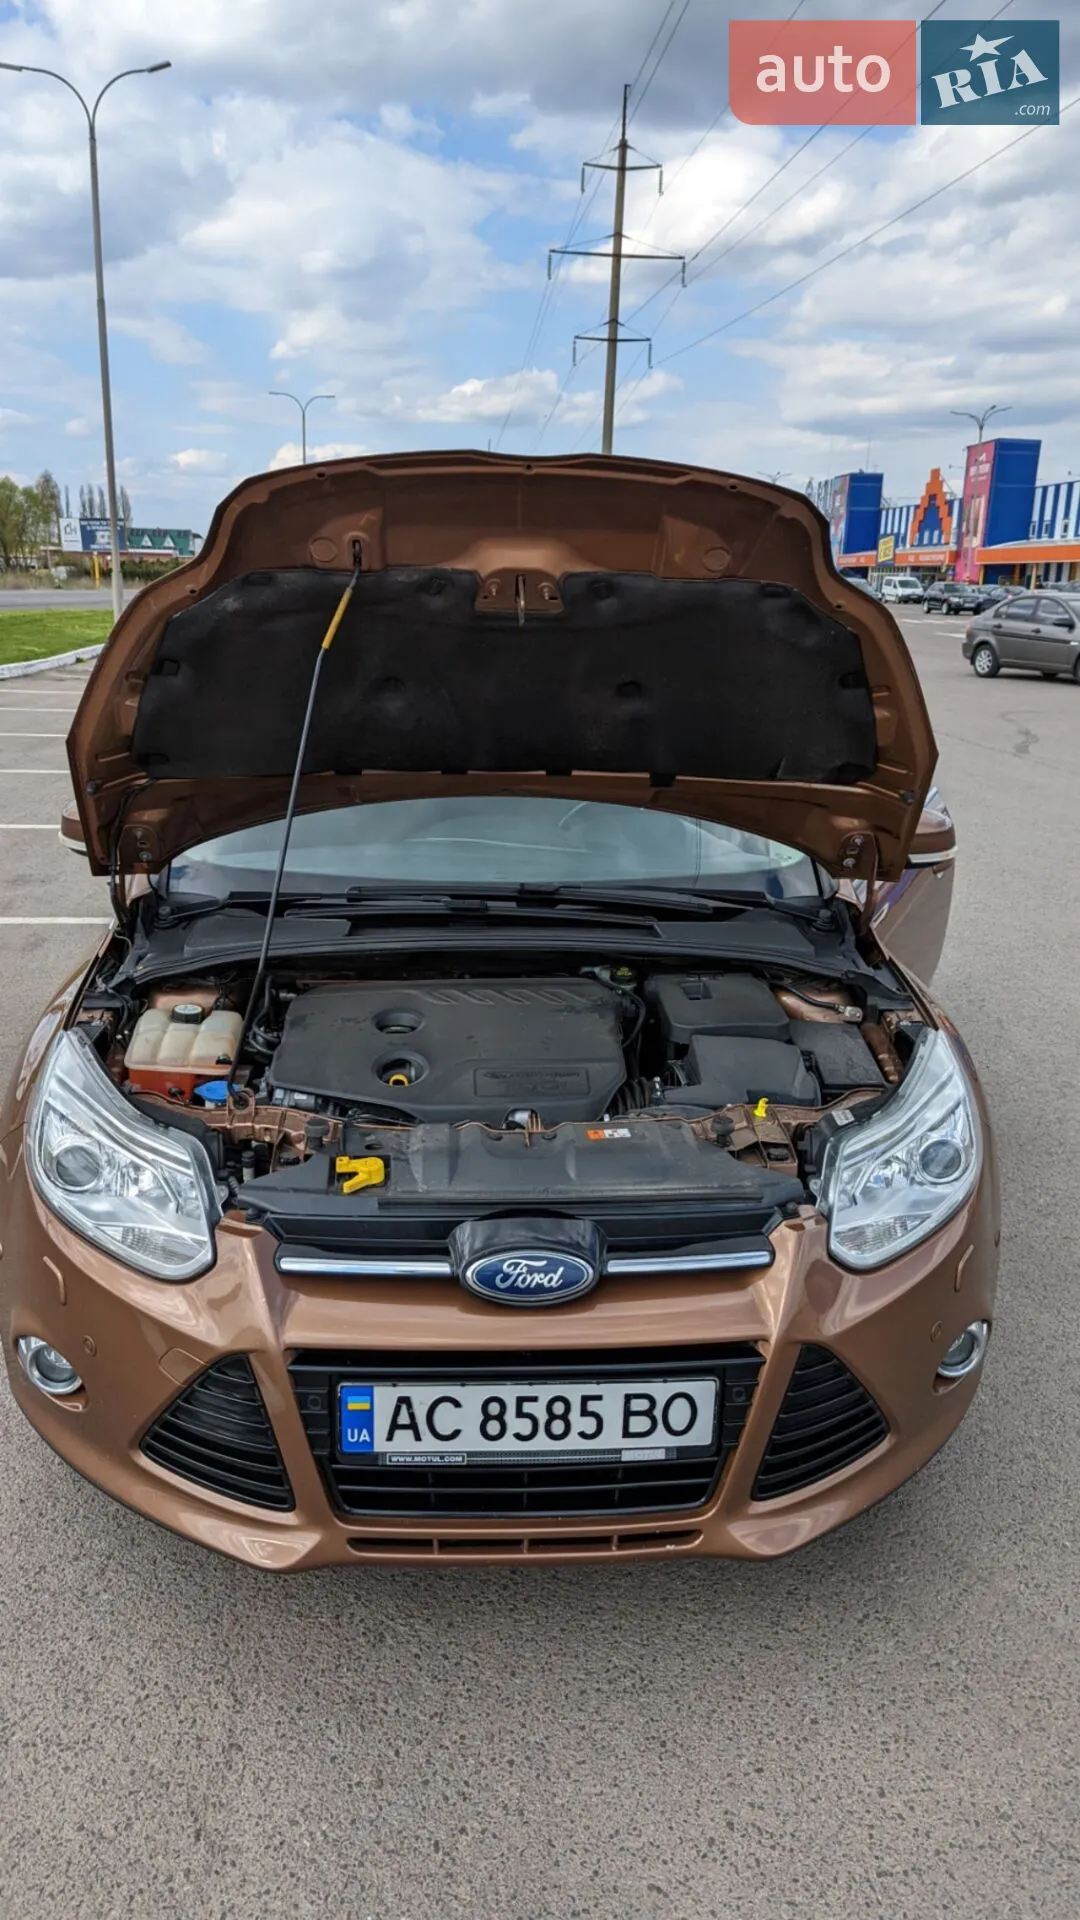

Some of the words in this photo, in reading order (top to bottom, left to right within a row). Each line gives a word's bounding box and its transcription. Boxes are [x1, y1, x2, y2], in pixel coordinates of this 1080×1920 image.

[495, 1259, 563, 1289] Ford
[385, 1395, 463, 1442] AC
[479, 1394, 604, 1442] 8585
[621, 1391, 698, 1439] BO
[347, 1427, 371, 1443] UA
[390, 1455, 463, 1463] WWW.MOTUL.COM
